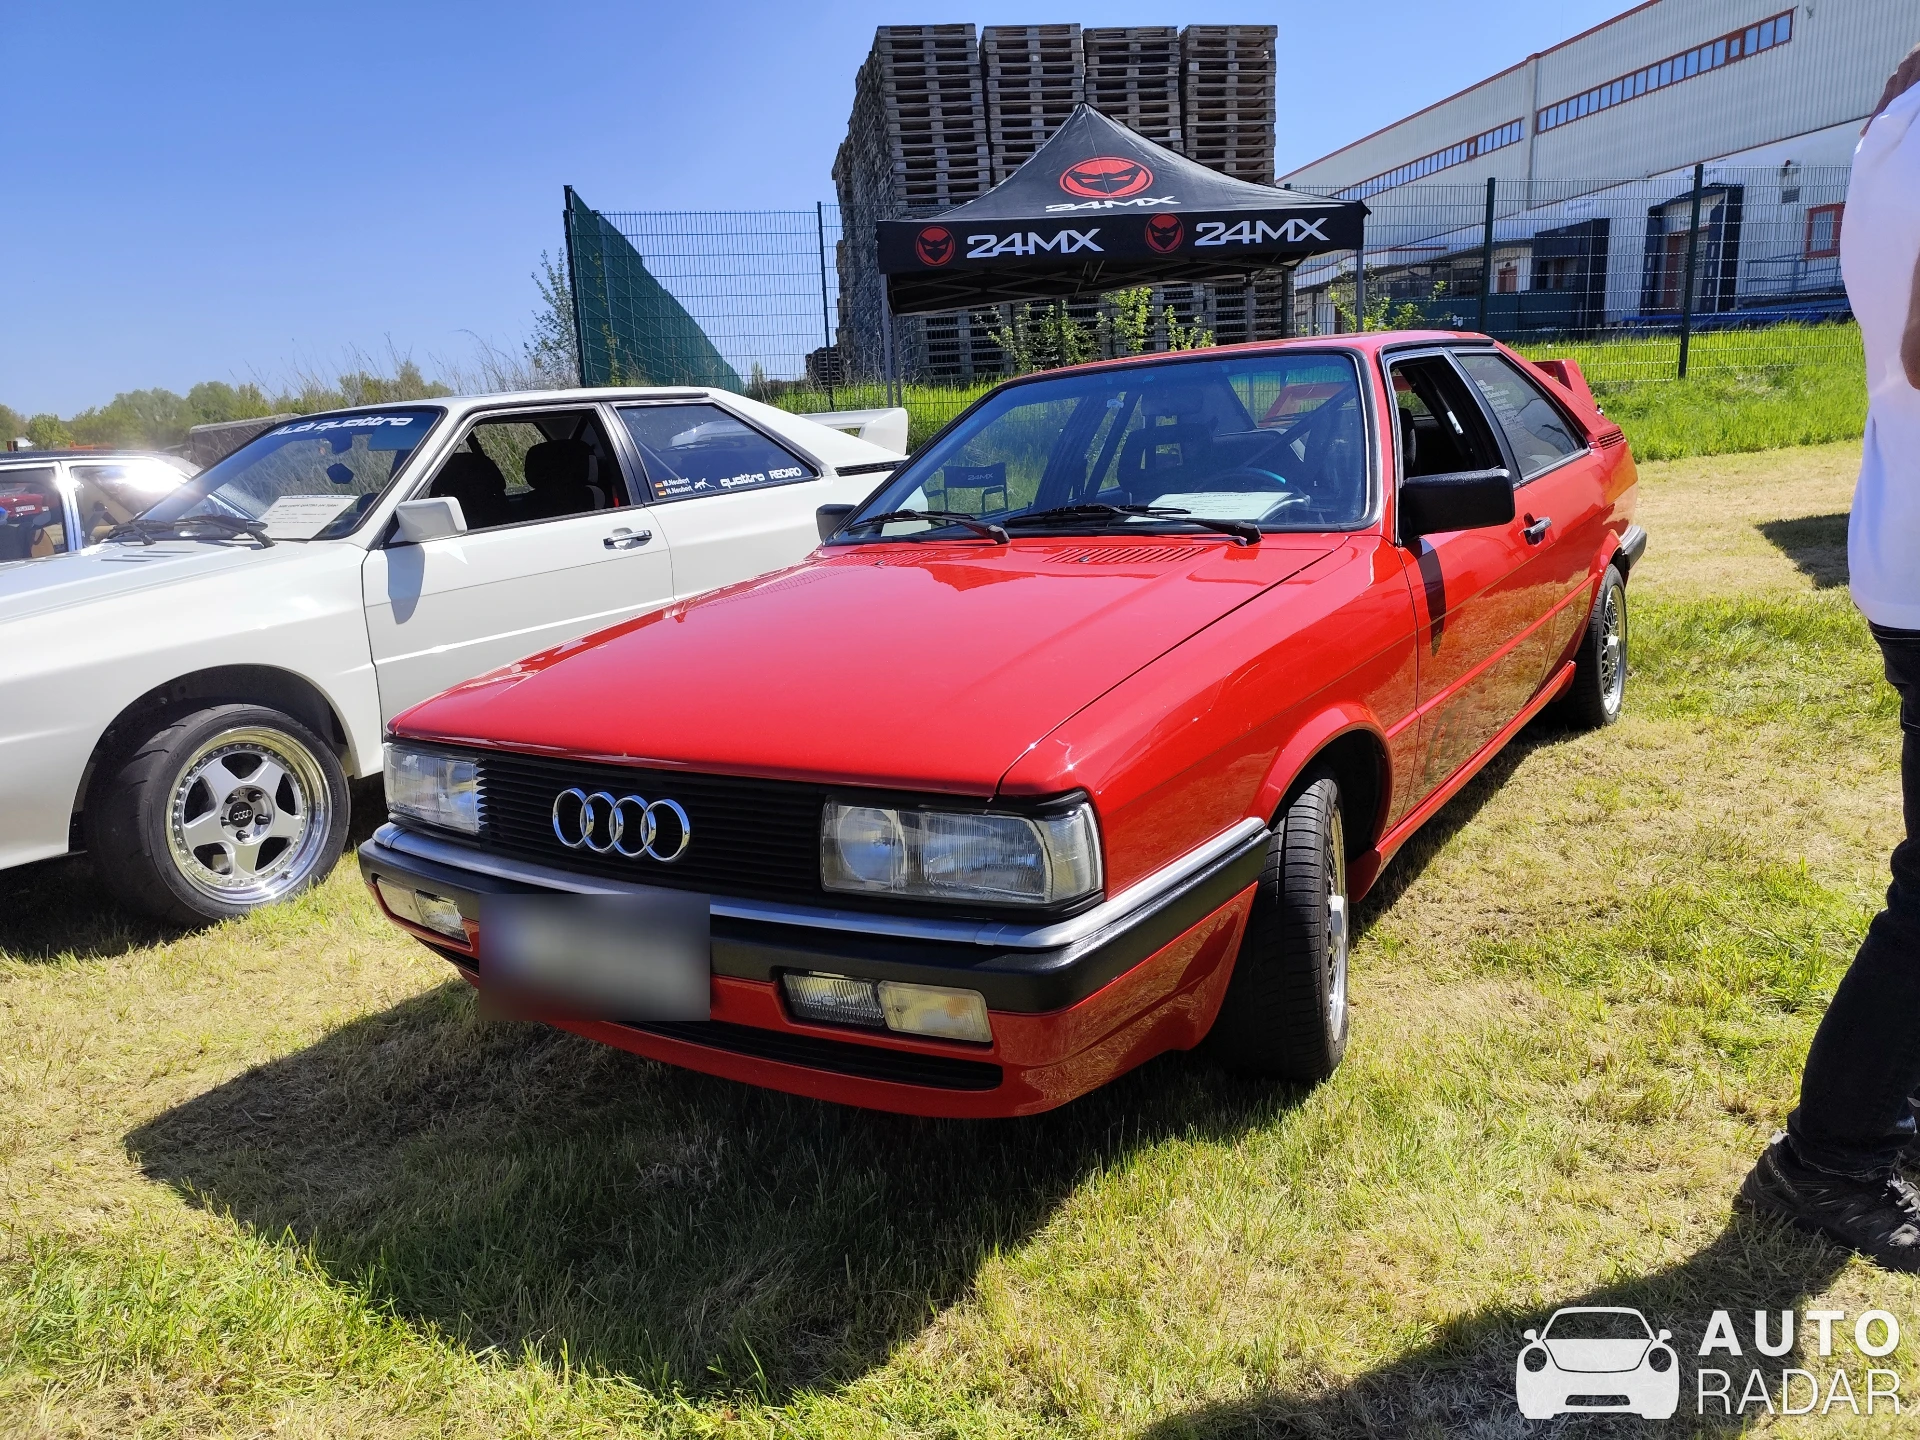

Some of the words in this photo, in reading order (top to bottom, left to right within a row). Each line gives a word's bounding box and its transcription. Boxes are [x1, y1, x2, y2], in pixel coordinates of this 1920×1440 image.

[1045, 195, 1181, 213] 24MX
[1194, 217, 1331, 247] 24MX
[966, 228, 1105, 260] 24MX
[316, 417, 413, 431] quattro
[720, 473, 765, 488] quattro
[768, 467, 802, 479] RECARO
